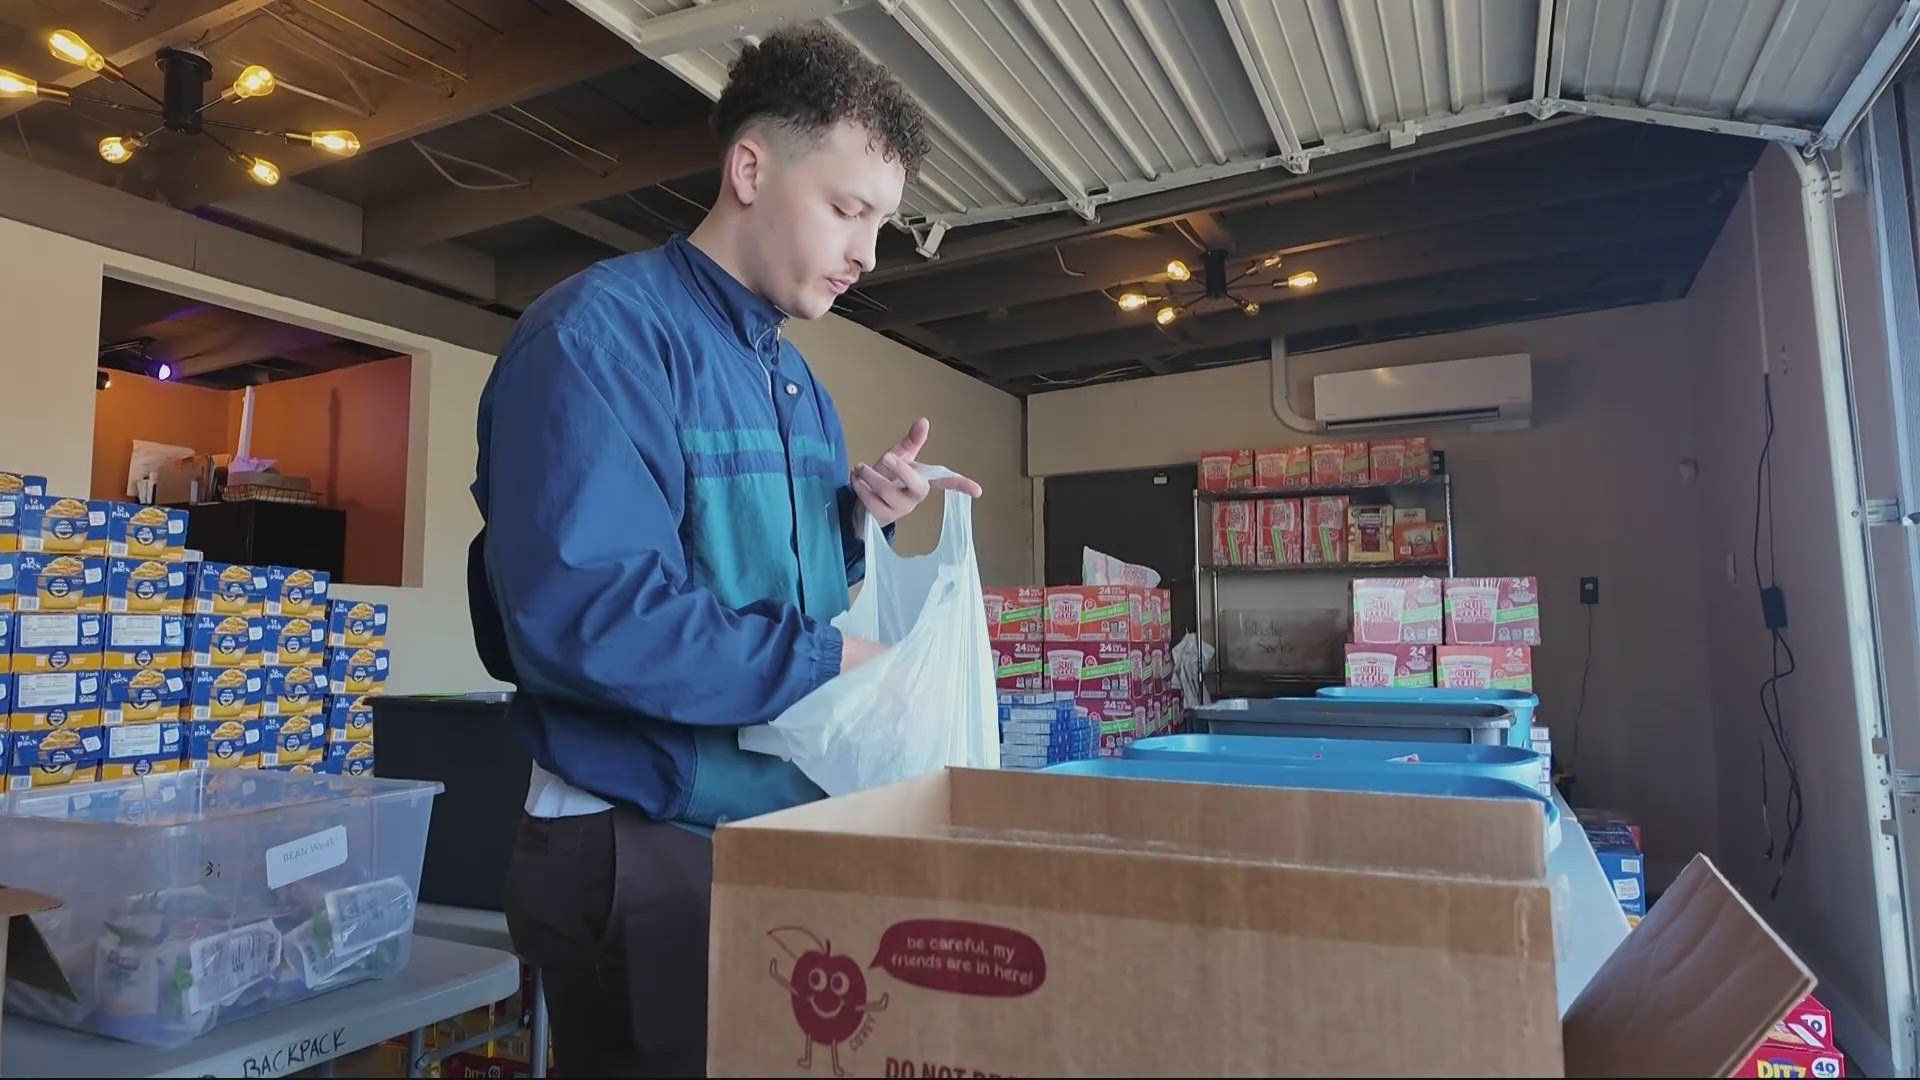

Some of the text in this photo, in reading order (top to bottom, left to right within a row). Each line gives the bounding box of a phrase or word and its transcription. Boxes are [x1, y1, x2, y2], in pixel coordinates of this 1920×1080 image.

[1418, 580, 1434, 589] 24
[1512, 578, 1530, 588] 24
[1019, 588, 1030, 596] 24
[1099, 587, 1111, 595] 24
[1015, 643, 1027, 652] 24
[1100, 643, 1112, 652] 24
[1409, 646, 1426, 656] 24
[1506, 648, 1523, 657] 24
[1103, 701, 1116, 709] 24
[283, 838, 336, 863] BEAN Week
[907, 936, 1015, 966] be careful, my
[891, 953, 1033, 987] friends are in here!
[242, 1026, 347, 1078] BACKPACK
[885, 1056, 915, 1078] DO
[1814, 1061, 1836, 1074] 40
